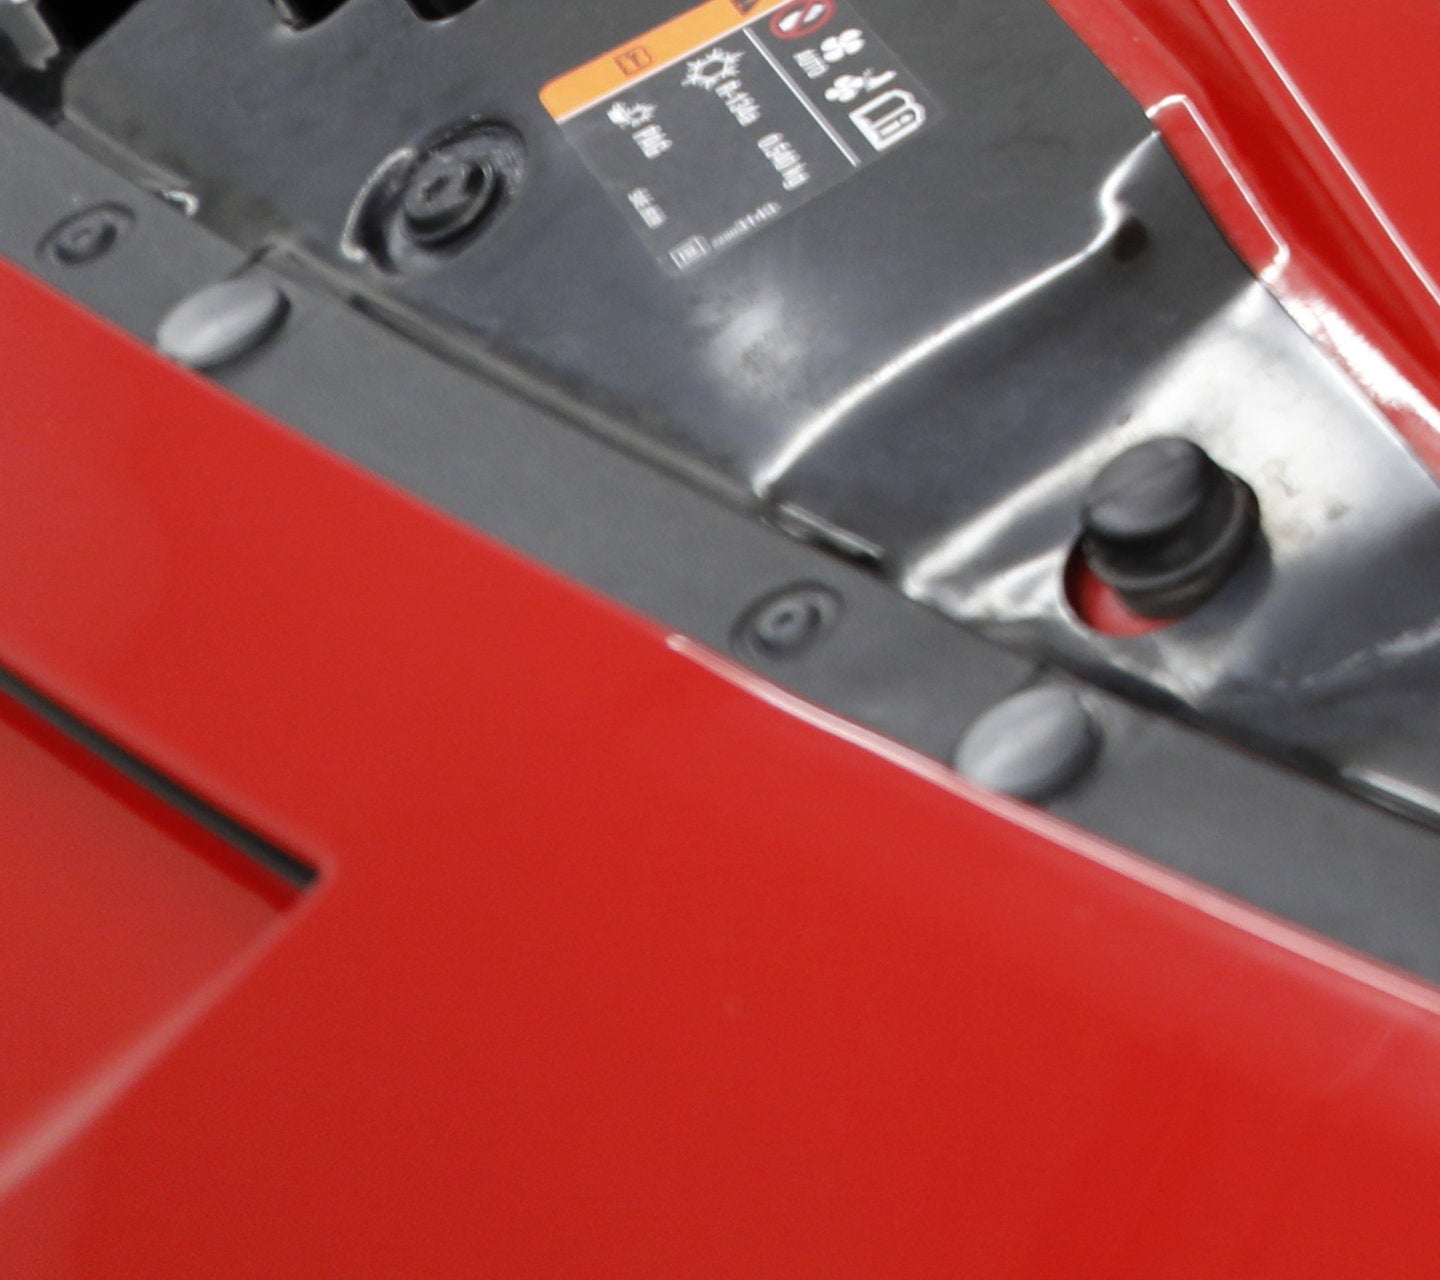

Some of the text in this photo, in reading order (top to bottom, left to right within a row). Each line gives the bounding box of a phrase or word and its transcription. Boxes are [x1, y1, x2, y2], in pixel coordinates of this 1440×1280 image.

[793, 48, 830, 80] AUTO
[631, 123, 674, 160] PAG
[782, 161, 811, 191] kg
